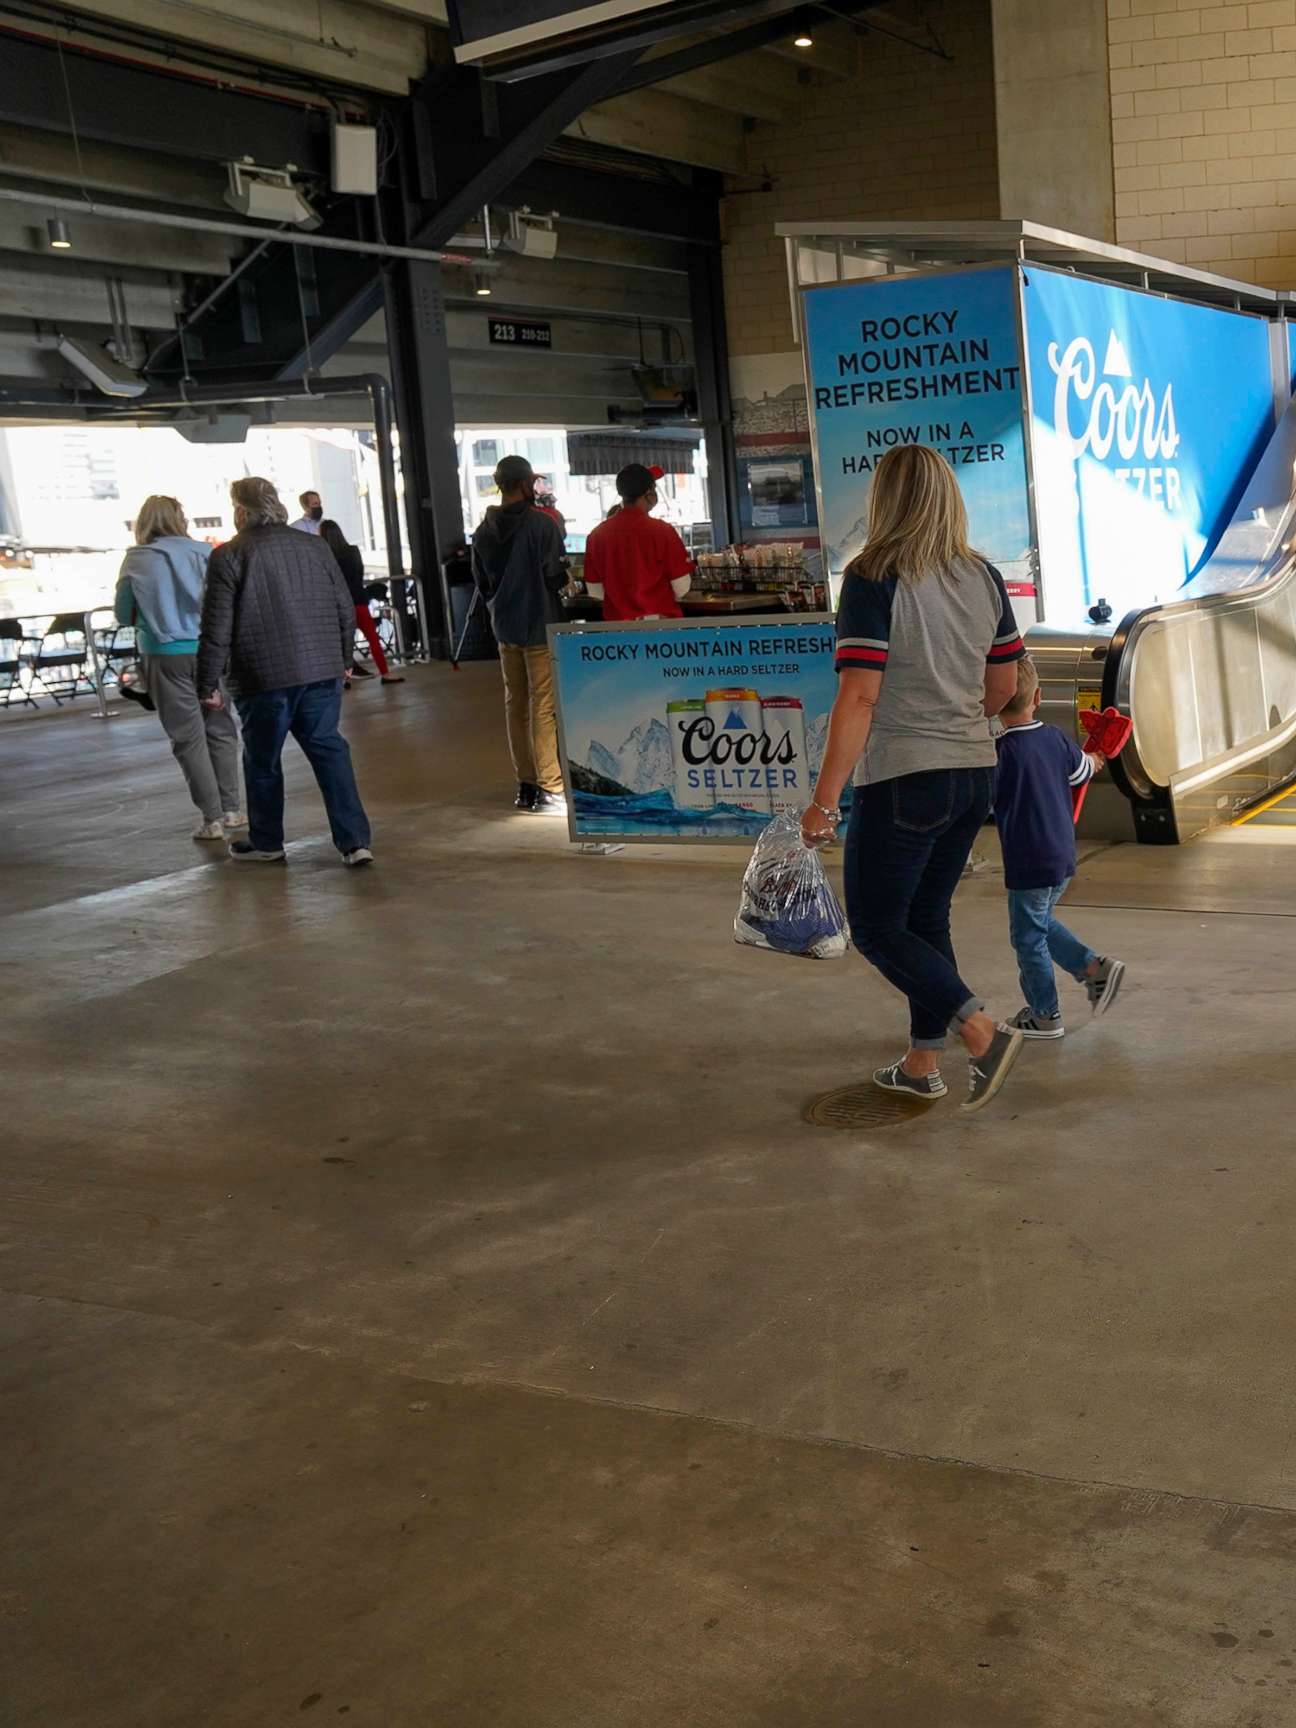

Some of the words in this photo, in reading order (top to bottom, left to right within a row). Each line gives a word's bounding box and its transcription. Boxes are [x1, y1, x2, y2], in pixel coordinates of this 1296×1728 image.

[494, 324, 515, 341] 213
[861, 310, 959, 343] ROCKY
[838, 339, 990, 377] MOUNTAIN
[815, 367, 1020, 410] REFRESHMENT
[1048, 337, 1180, 460] Coors
[867, 426, 921, 448] NOW
[929, 423, 951, 442] IN
[960, 421, 975, 439] A
[842, 454, 883, 474] HA
[581, 644, 640, 662] ROCKY
[645, 640, 742, 659] MOUNTAIN
[749, 636, 837, 656] REFRESH
[663, 667, 690, 677] NOW
[693, 667, 704, 676] IN
[707, 667, 715, 676] A
[718, 665, 749, 676] HARD
[751, 664, 800, 675] SELTZER
[678, 716, 798, 766] Coors
[687, 768, 799, 789] SELTZER
